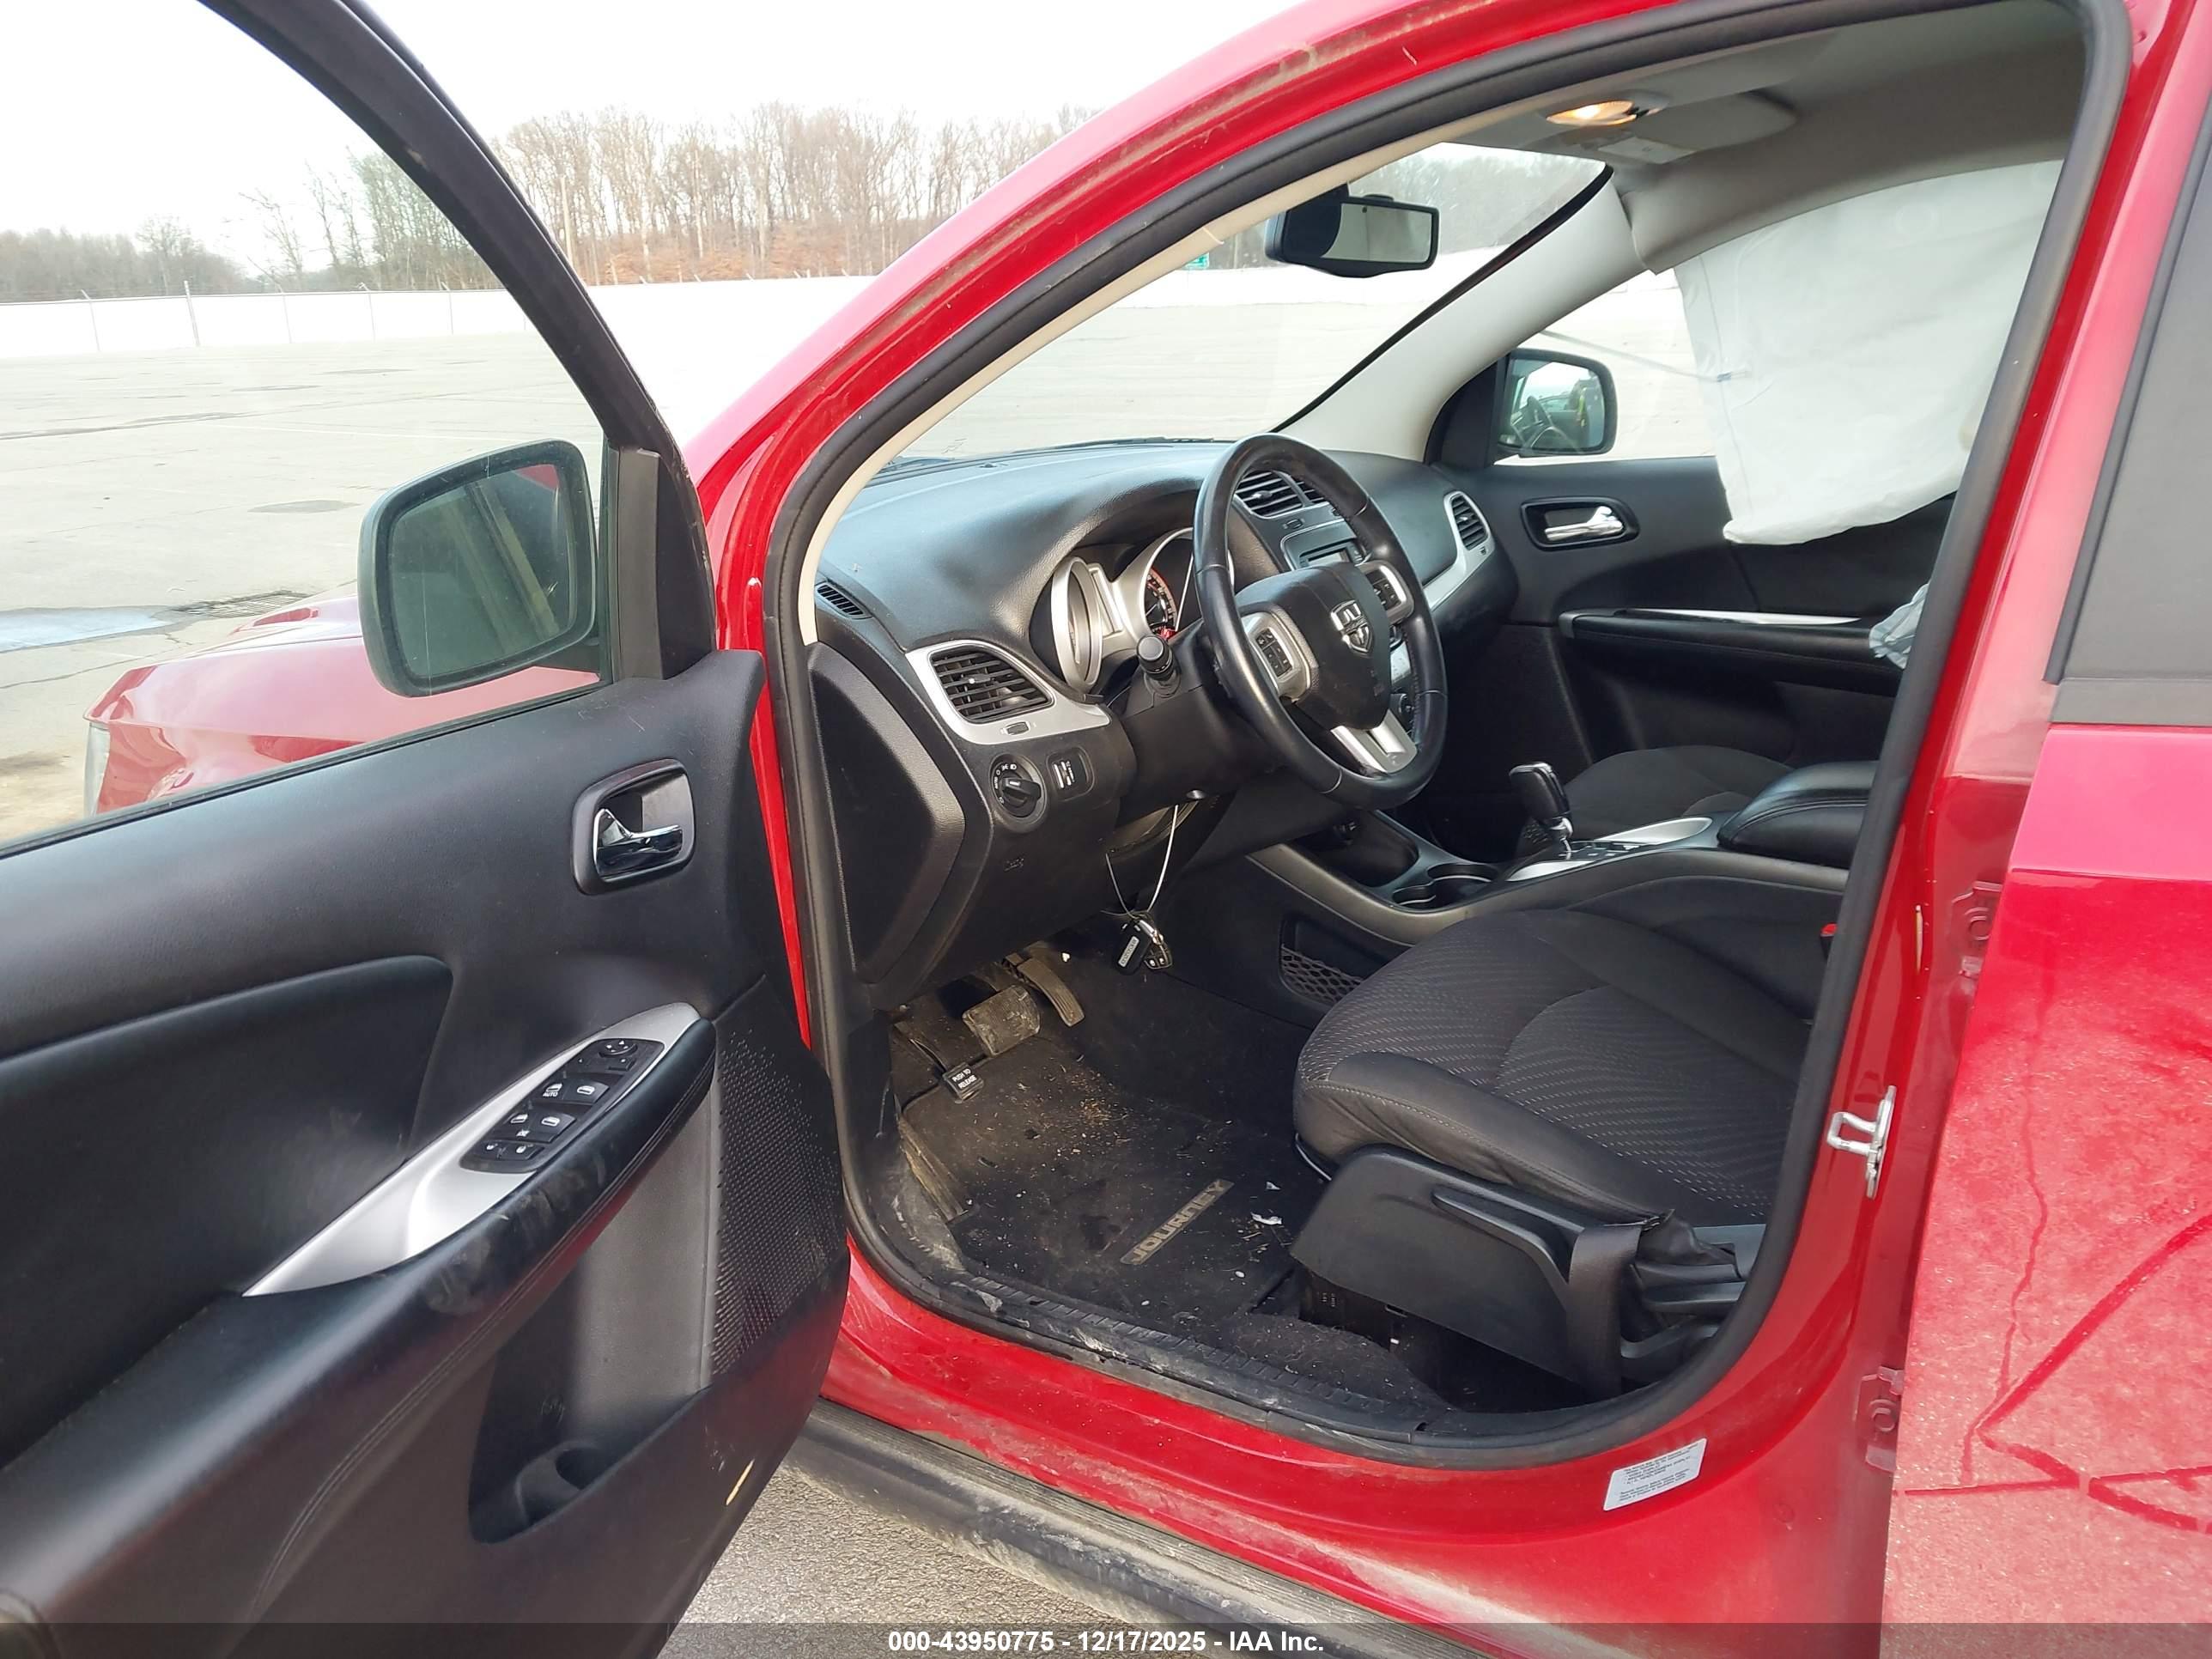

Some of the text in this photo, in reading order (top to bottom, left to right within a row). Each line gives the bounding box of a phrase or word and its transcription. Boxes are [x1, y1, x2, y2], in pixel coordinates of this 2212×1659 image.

[951, 1073, 965, 1083] PUSH
[957, 1074, 977, 1089] RELEASE
[1131, 1179, 1224, 1264] JOURNEY
